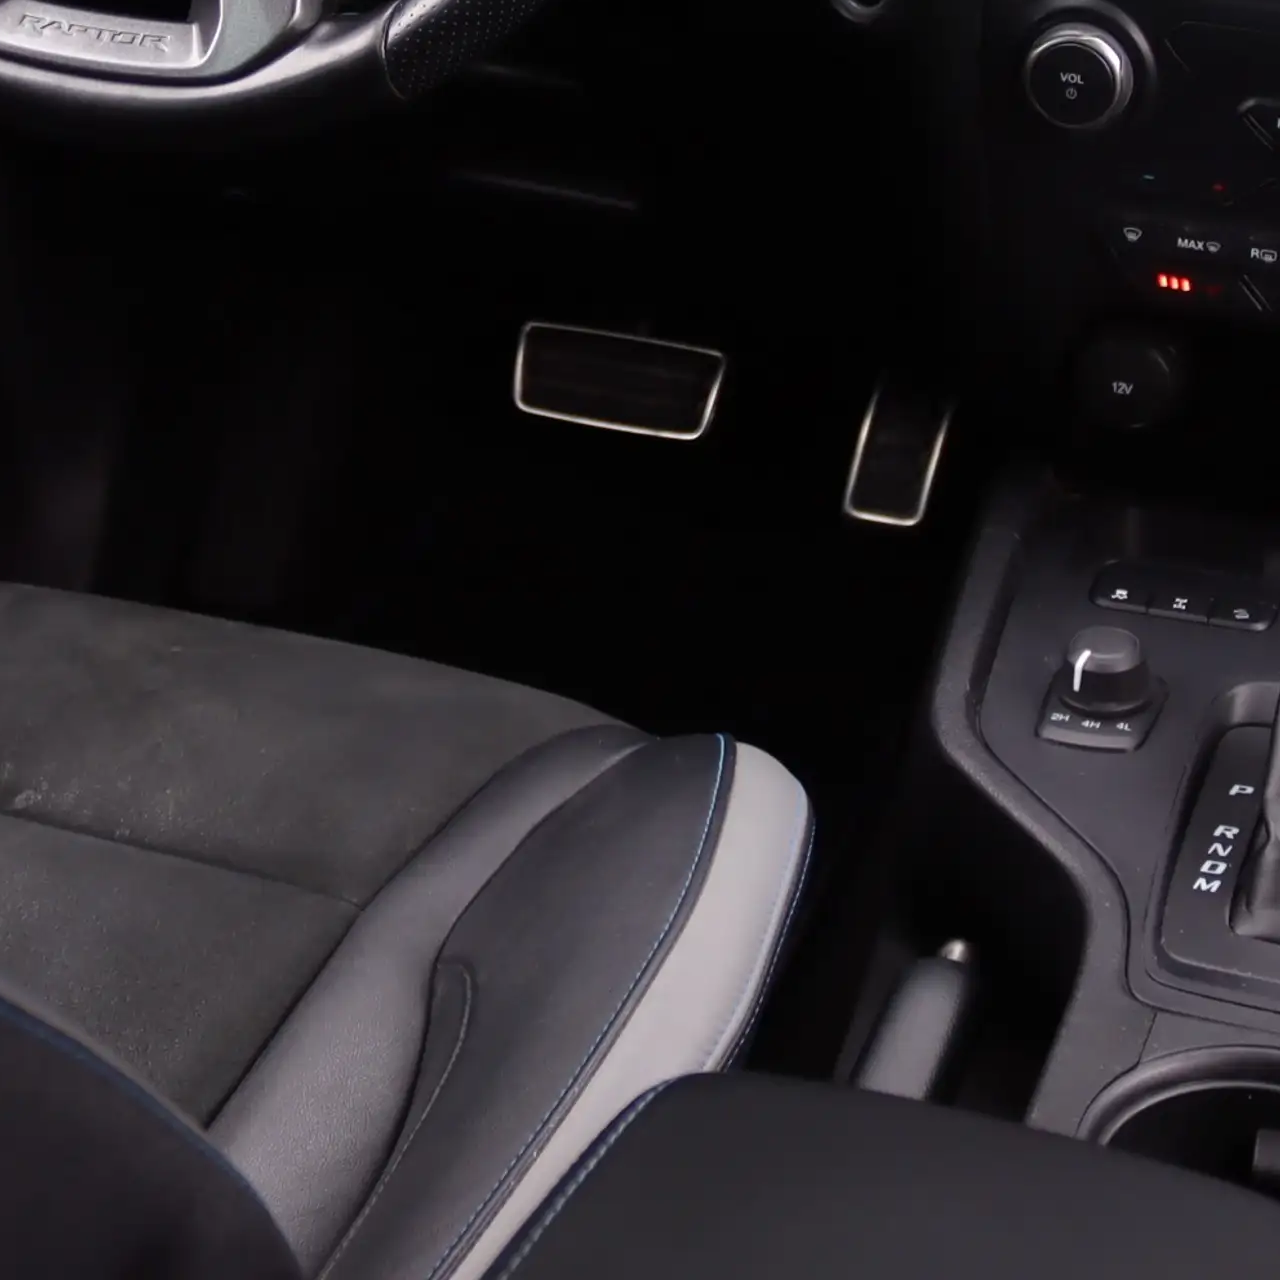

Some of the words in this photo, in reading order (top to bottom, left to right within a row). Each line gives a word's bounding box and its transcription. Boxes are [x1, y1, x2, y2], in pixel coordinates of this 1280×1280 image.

[19, 13, 171, 54] RAPTOR
[1060, 72, 1084, 85] VOL
[1177, 237, 1205, 251] MAX
[1111, 381, 1134, 396] 12V
[1081, 719, 1101, 730] 4H
[1116, 722, 1132, 732] 4L
[1228, 784, 1255, 796] P
[1213, 824, 1240, 840] R
[1207, 842, 1233, 857] N
[1200, 860, 1228, 875] D
[1193, 877, 1222, 893] M
